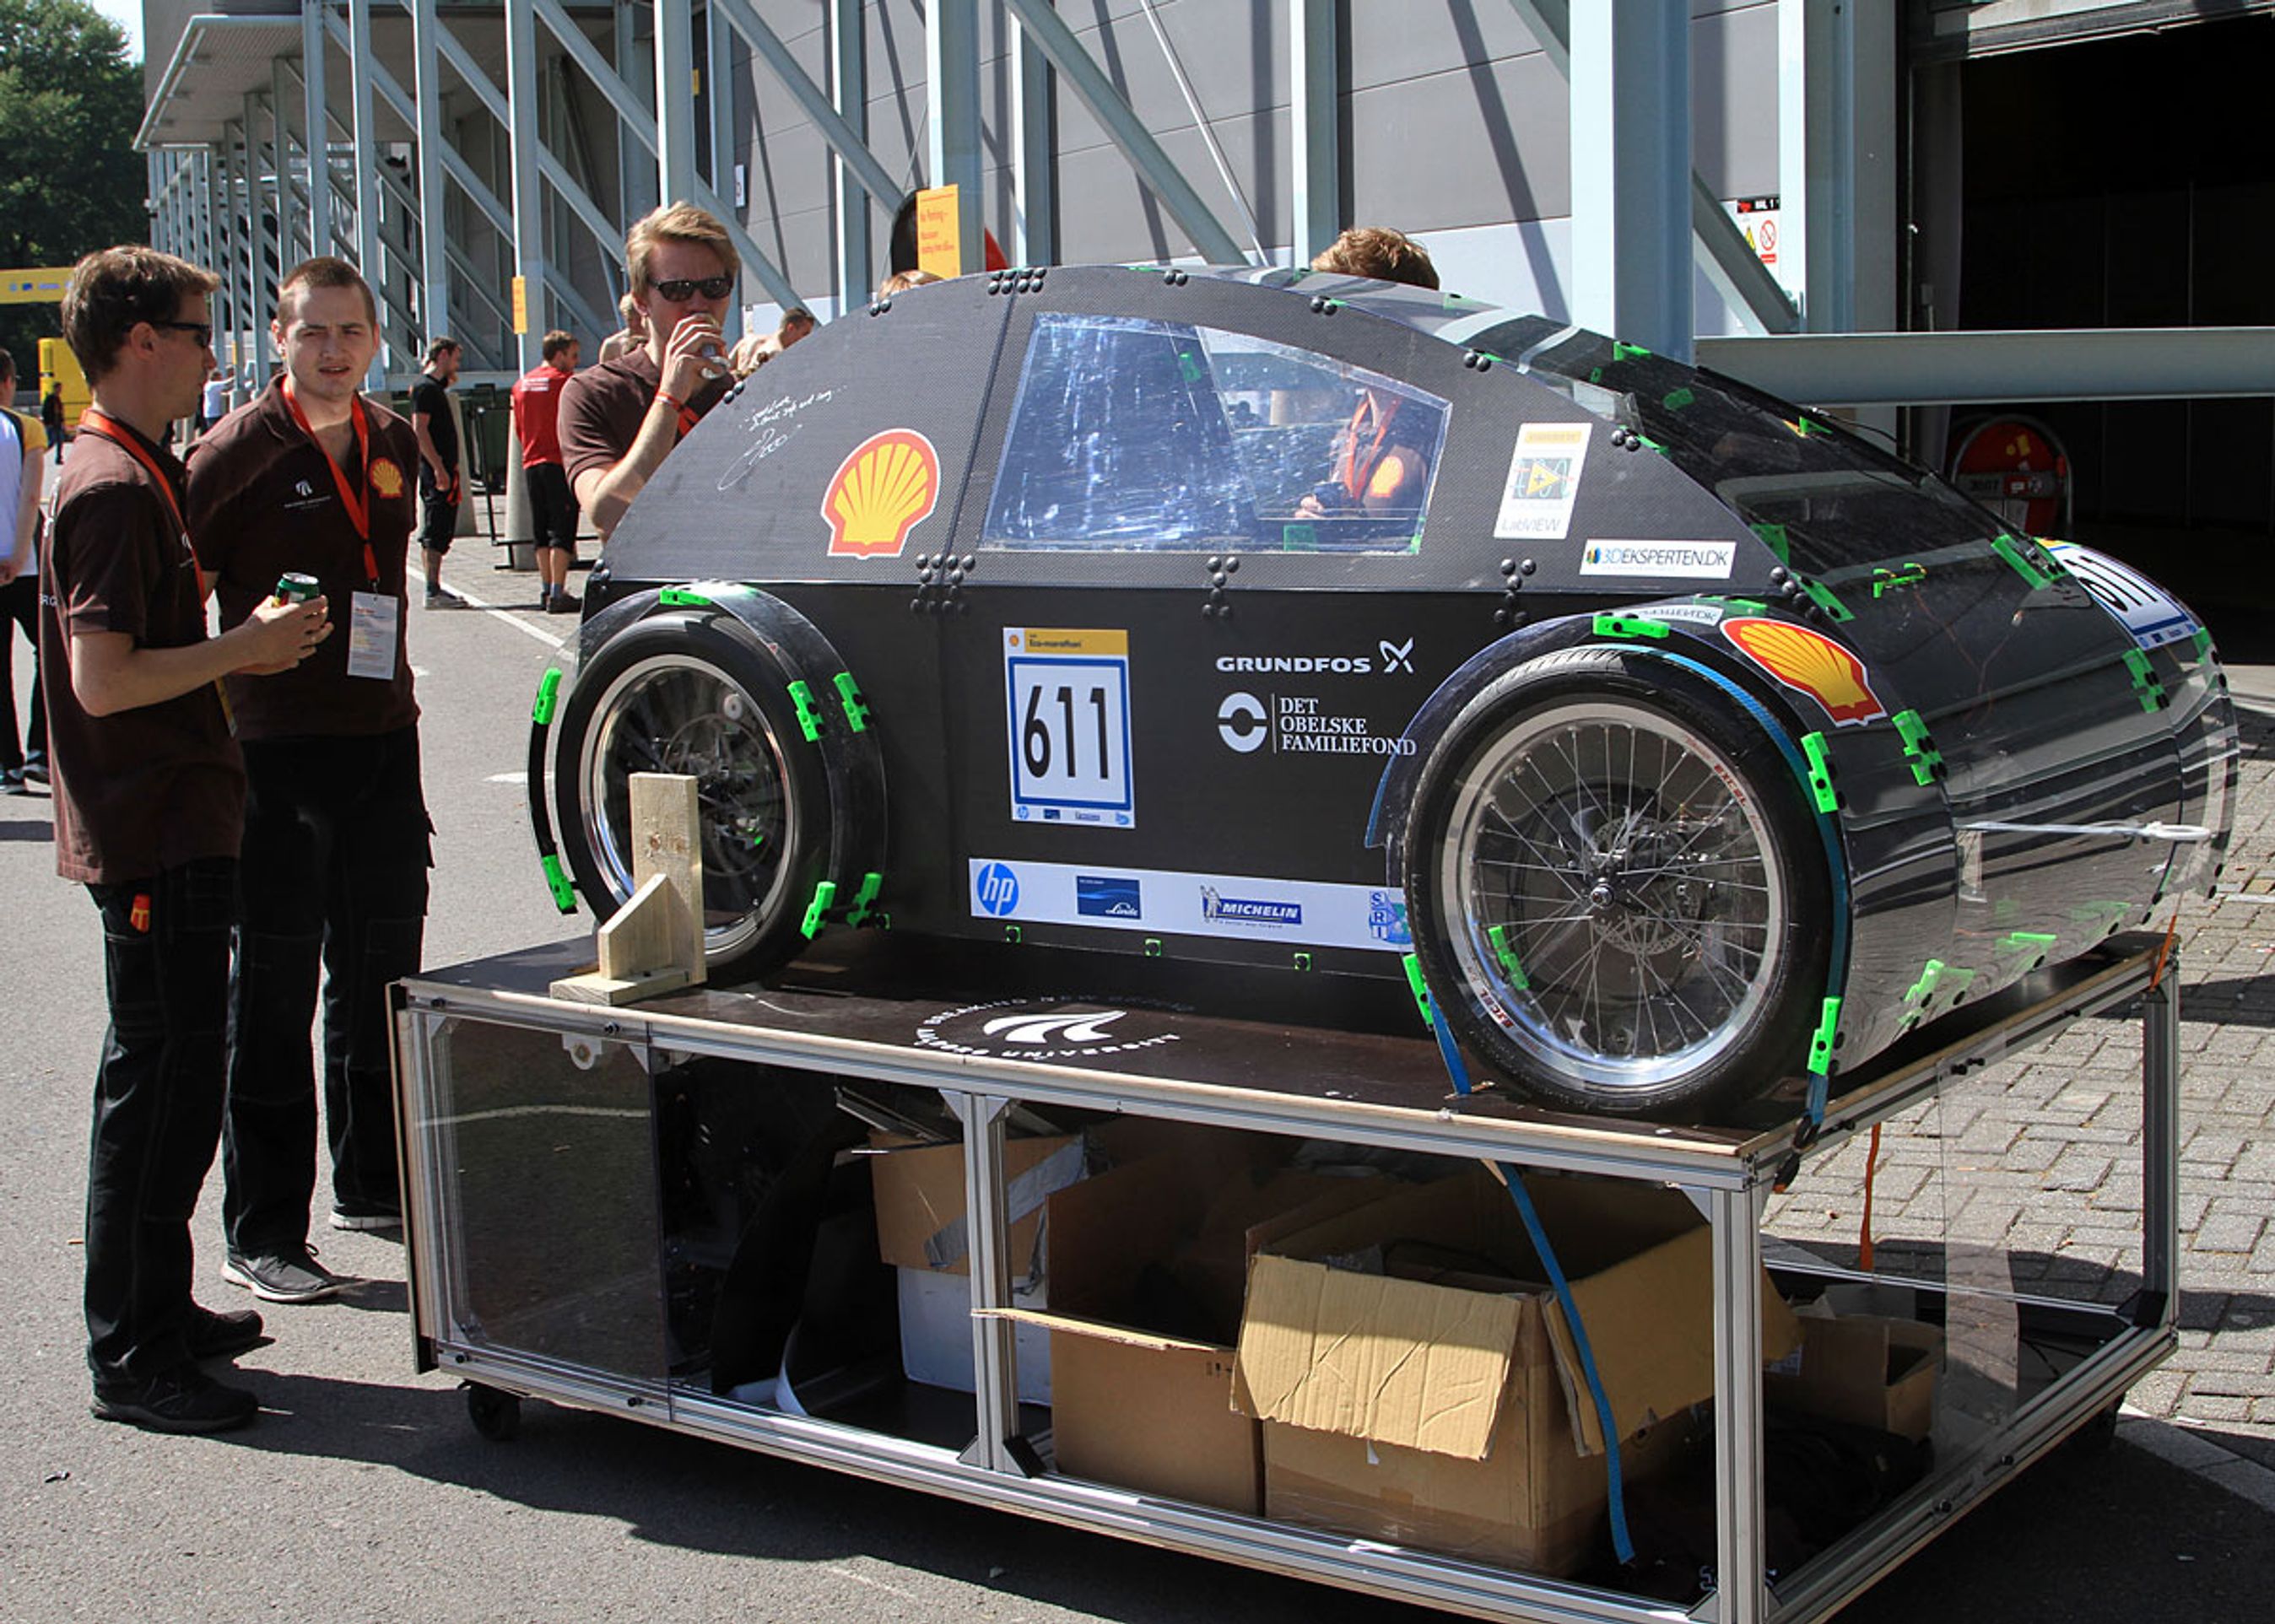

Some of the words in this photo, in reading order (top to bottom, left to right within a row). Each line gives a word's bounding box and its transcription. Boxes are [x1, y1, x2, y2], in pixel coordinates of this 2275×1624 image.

[1500, 517, 1560, 532] LabVIEW
[1602, 547, 1729, 566] 3DEKSPERTEN.DK
[1215, 656, 1372, 673] GRUNDFOS
[1279, 697, 1319, 715] DET
[1024, 685, 1109, 780] 611
[1280, 716, 1367, 735] OBELSKE
[1282, 734, 1418, 756] FAMILIEFOND
[981, 862, 1015, 916] hp
[1105, 902, 1139, 917] Linde
[1222, 903, 1299, 919] MICHELIN
[1001, 1033, 1181, 1058] UNIVERSITY
